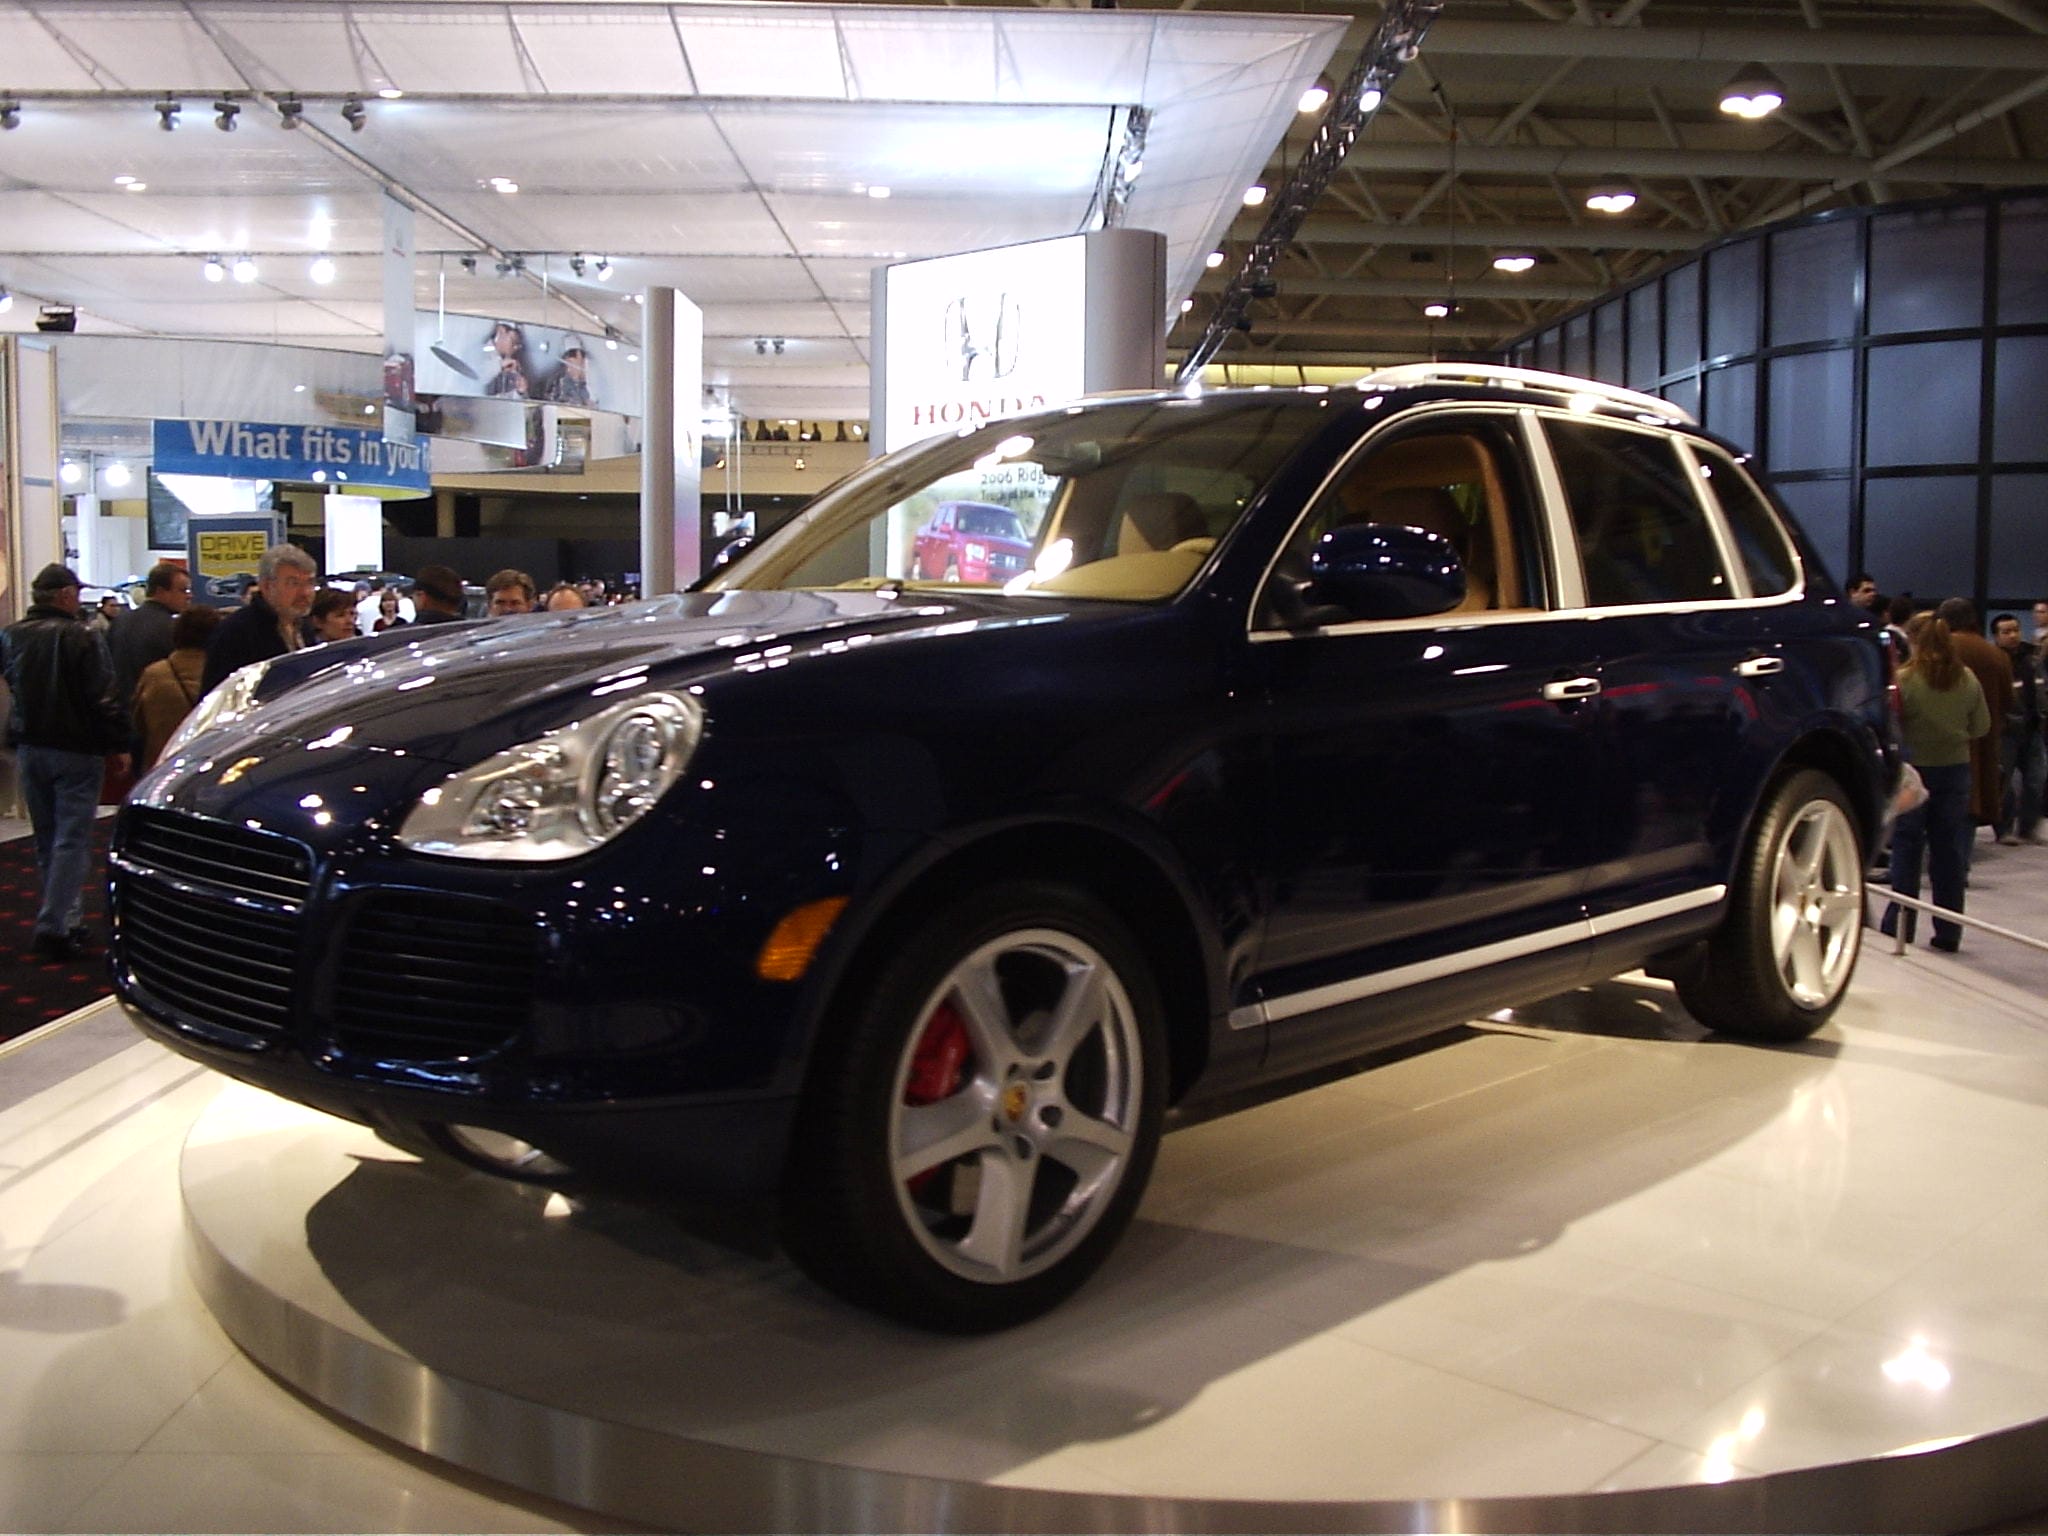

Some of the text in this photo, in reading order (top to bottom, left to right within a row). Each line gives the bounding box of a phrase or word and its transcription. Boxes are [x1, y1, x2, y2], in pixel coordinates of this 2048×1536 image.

[913, 395, 1045, 425] HONDA
[189, 420, 291, 459] What
[302, 426, 352, 464] fits
[360, 431, 380, 465] in
[981, 469, 1012, 484] 2006
[201, 535, 264, 551] DRIVE
